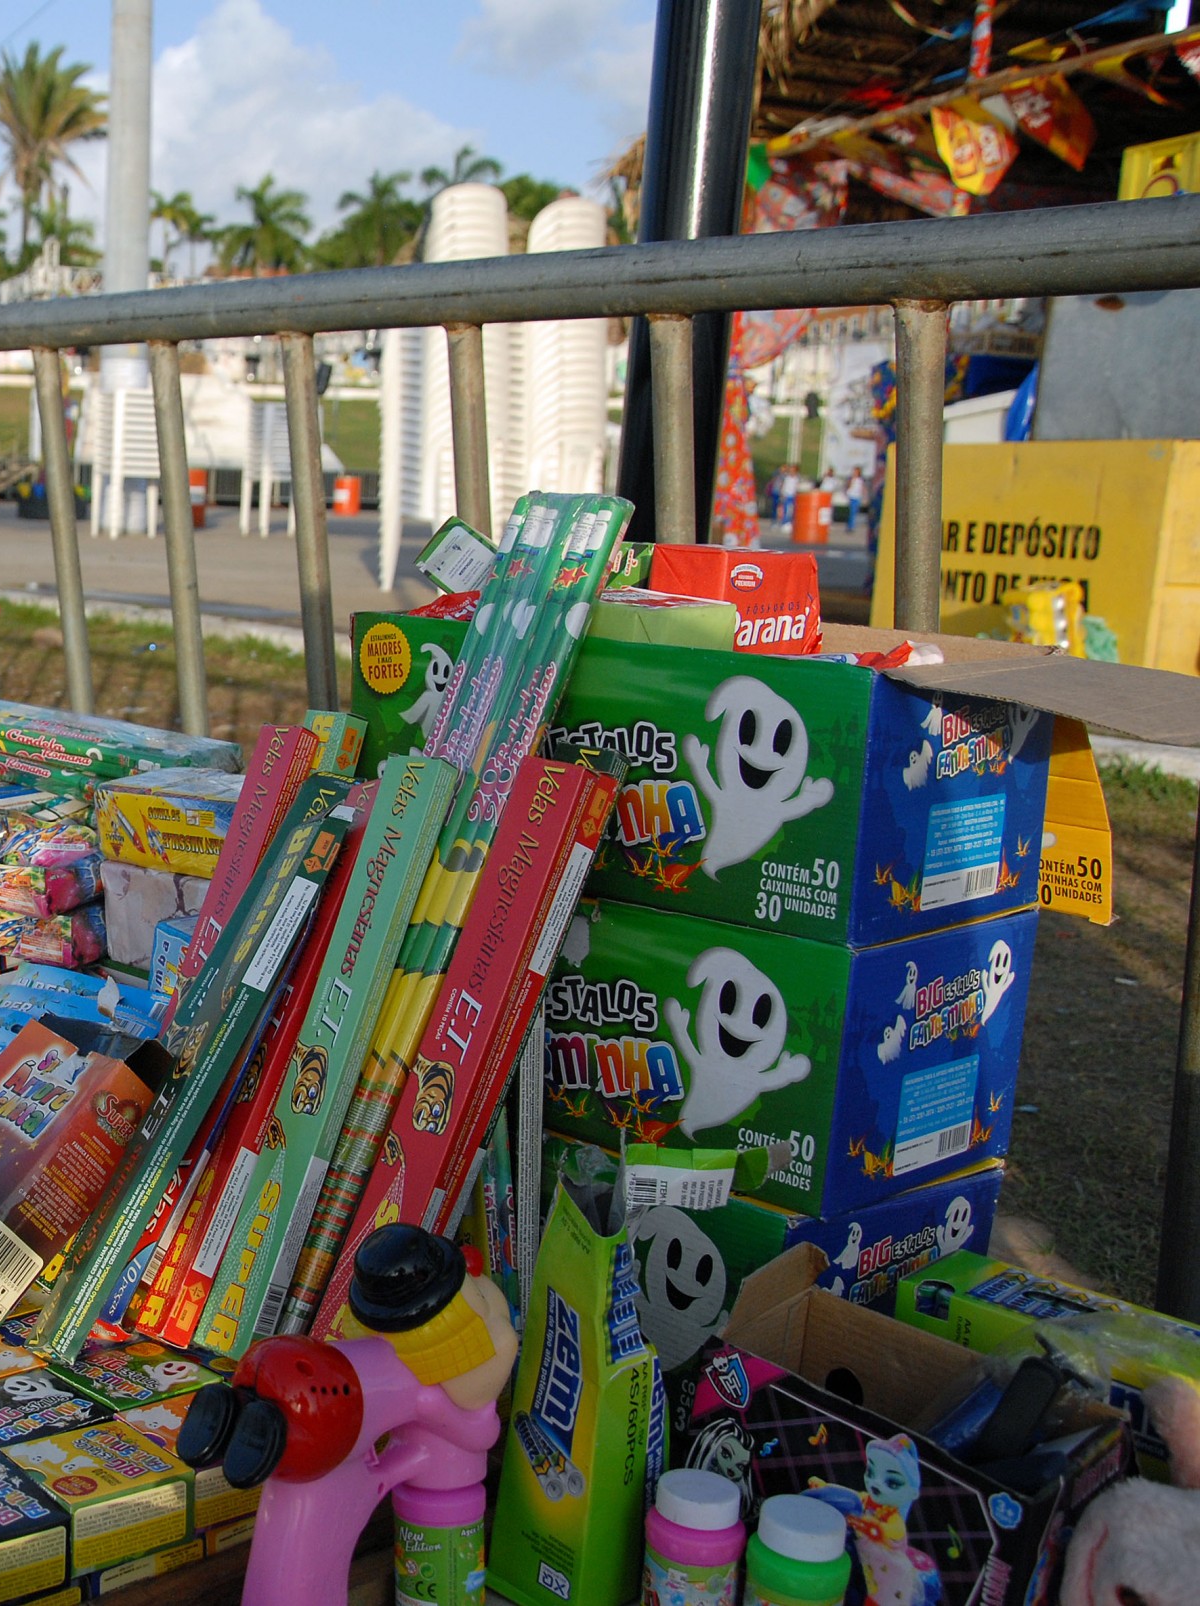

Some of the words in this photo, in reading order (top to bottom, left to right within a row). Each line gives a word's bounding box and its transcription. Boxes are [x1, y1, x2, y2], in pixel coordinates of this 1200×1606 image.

[982, 517, 1101, 561] DEPÓSITO
[367, 641, 403, 657] MAIORES
[368, 663, 404, 680] FORTES
[510, 661, 557, 766] Baladas
[941, 705, 970, 748] BIG
[5, 728, 65, 753] Candela
[42, 748, 92, 766] Romana
[261, 727, 290, 777] Velas
[5, 757, 52, 779] Romana
[392, 761, 426, 819] Velas
[524, 764, 567, 827] Velas
[761, 861, 810, 884] CONTÉM
[810, 858, 840, 889] 50
[1039, 858, 1075, 879] ONTÉM
[1077, 856, 1102, 881] 50
[341, 825, 403, 979] Magnesianas
[759, 878, 812, 900] CAIXINHAS
[813, 889, 838, 905] COM
[1054, 886, 1103, 905] UNIDADES
[1080, 880, 1102, 893] COM
[464, 828, 541, 998] Magnesianas
[754, 891, 782, 922] 30
[784, 898, 836, 920] UNIDADES
[444, 987, 457, 1013] CONTÉM
[549, 975, 658, 1031] STALOS
[916, 977, 944, 1018] BIG
[944, 968, 981, 998] ESTALOS
[433, 1021, 445, 1040] PEÇAS
[910, 989, 984, 1050] FANTASMINHA
[788, 1130, 815, 1162] 50
[789, 1161, 812, 1178] COM
[146, 1157, 189, 1236] Velas
[659, 1180, 668, 1199] ITEM
[204, 1179, 281, 1352] SUPER
[858, 1236, 892, 1279] BIG
[891, 1225, 936, 1260] ESTALOS
[74, 1281, 89, 1304] EMISSÃO
[540, 1303, 583, 1432] zem
[543, 1347, 552, 1366] alta
[19, 1393, 71, 1415] ESTALOS
[533, 1367, 550, 1410] potência
[623, 1367, 639, 1485] 4S/60PCS
[81, 1427, 172, 1474] FANTASMINHA
[109, 1453, 149, 1480] BIG
[400, 1526, 424, 1541] New
[405, 1540, 442, 1553] Edition
